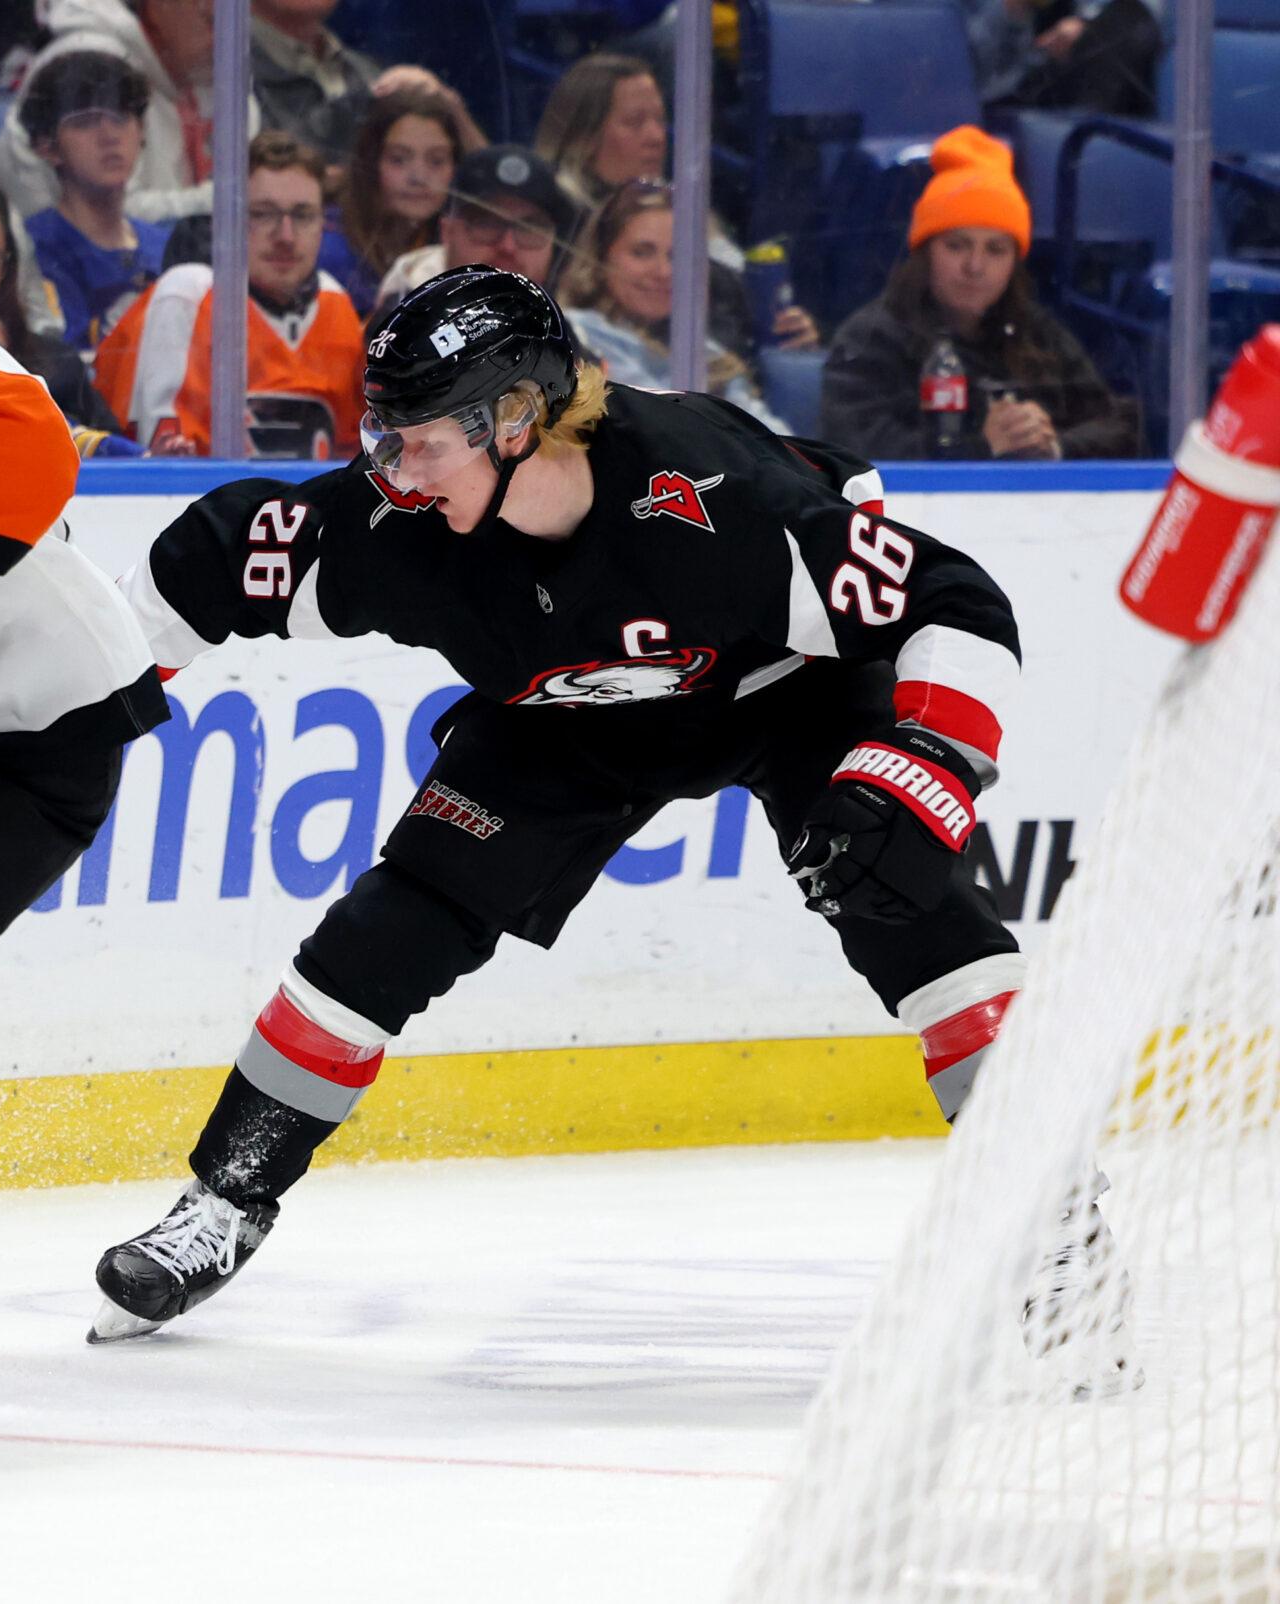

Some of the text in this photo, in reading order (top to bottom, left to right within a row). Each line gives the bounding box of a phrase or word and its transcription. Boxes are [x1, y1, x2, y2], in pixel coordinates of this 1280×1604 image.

[368, 329, 397, 358] 26
[243, 499, 307, 599] 26
[830, 511, 914, 626] 26
[622, 619, 672, 658] C
[910, 737, 945, 758] DAHLIN
[407, 789, 497, 840] SABRES
[430, 780, 505, 828] BUFFALO
[832, 747, 970, 841] WARRIOR
